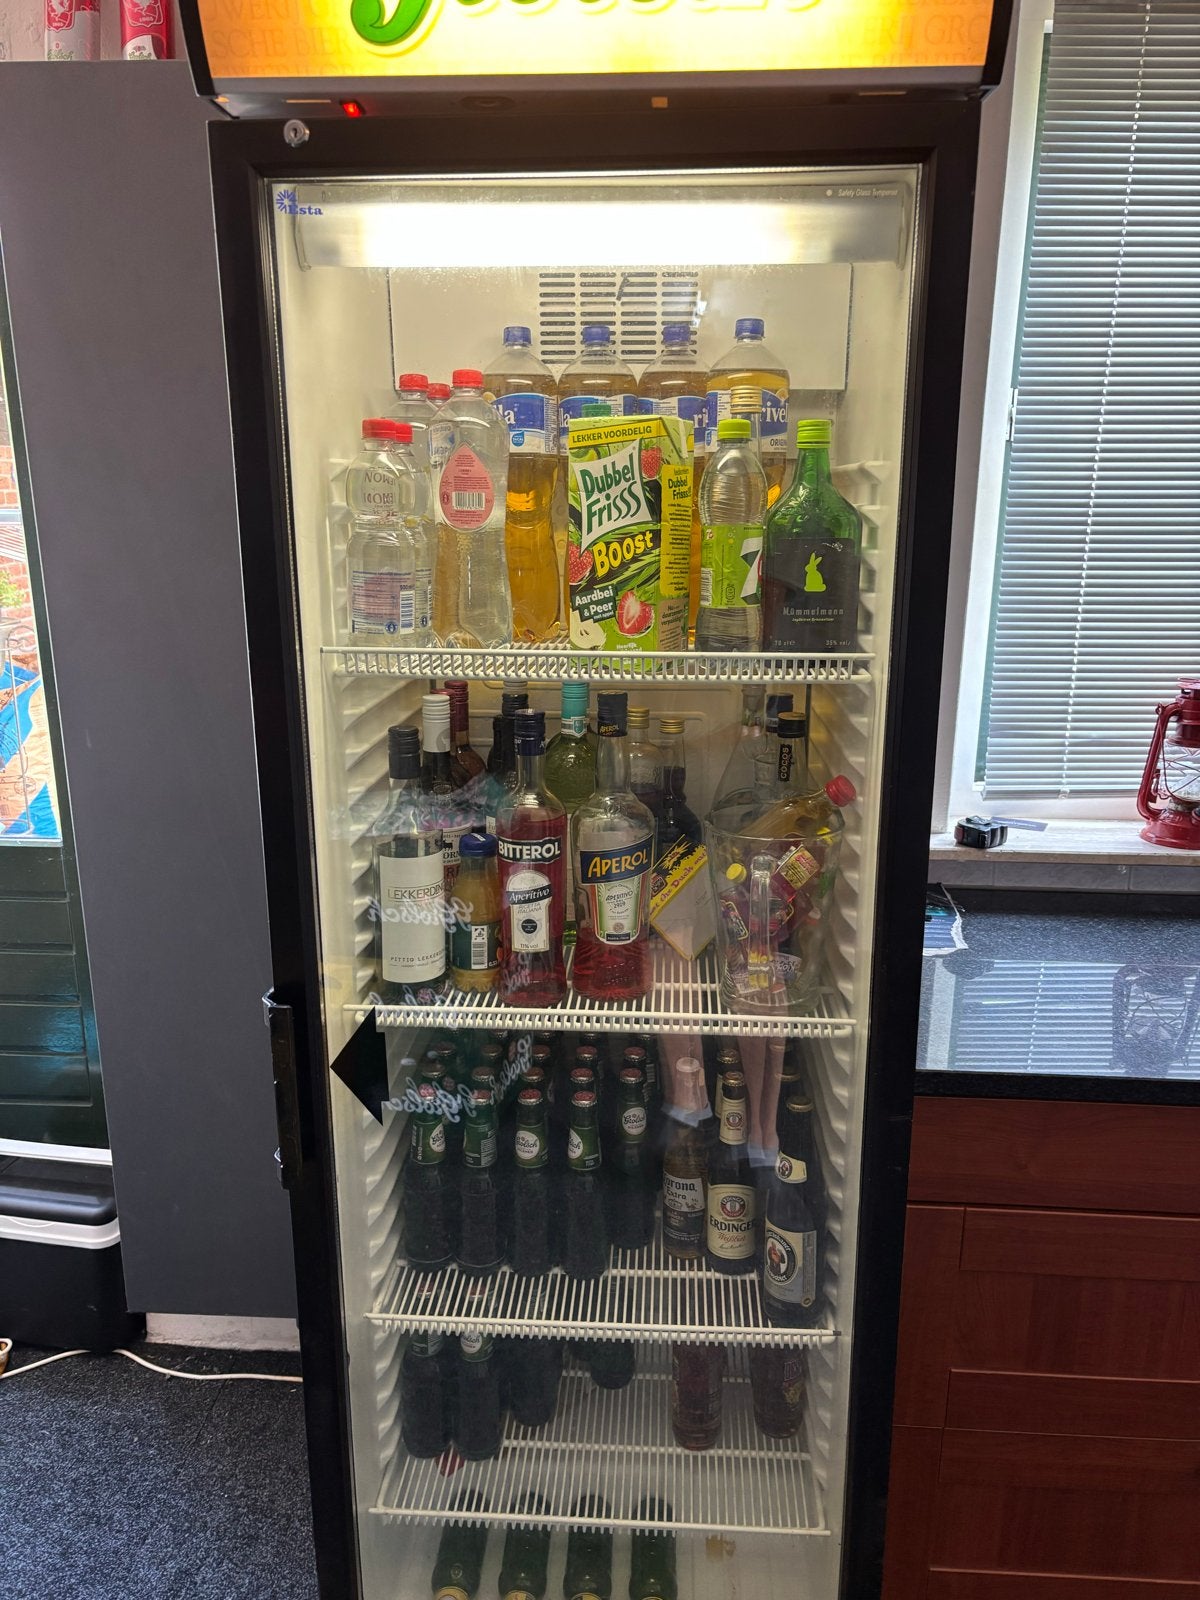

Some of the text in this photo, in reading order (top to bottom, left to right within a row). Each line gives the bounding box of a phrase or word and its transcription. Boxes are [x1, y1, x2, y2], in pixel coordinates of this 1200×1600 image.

[572, 425, 652, 443] LEKKER VOORDELIG
[579, 452, 636, 501] Dubbel
[668, 476, 688, 489] Dubbel
[586, 480, 642, 535] Frisss
[575, 586, 614, 606] Aardbei
[583, 602, 614, 617] & Peer
[781, 747, 789, 779] COCOS
[498, 840, 561, 860] BITTEROL
[587, 848, 649, 878] APEROL
[509, 887, 550, 903] Aperitivo
